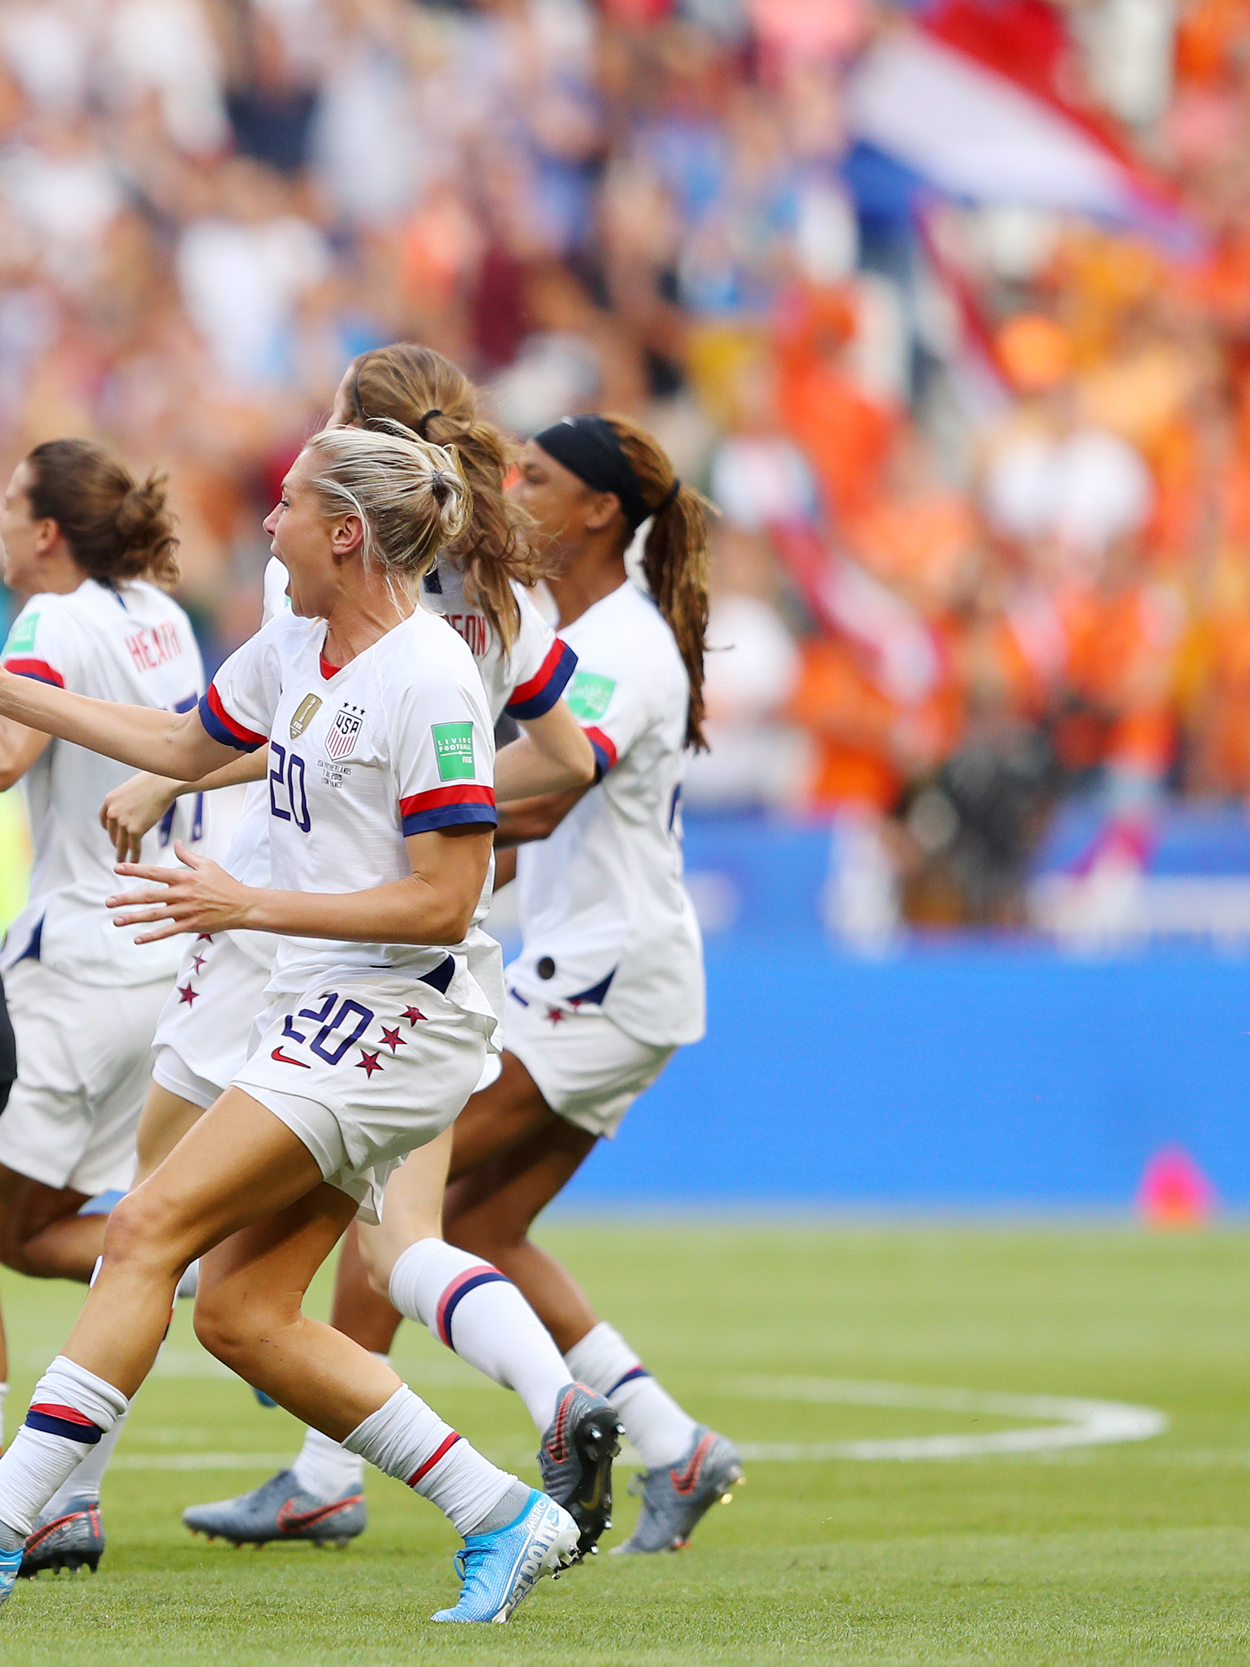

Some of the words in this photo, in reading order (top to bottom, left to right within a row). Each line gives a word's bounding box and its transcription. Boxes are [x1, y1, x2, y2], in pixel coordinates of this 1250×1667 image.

[336, 714, 359, 735] USA
[437, 737, 471, 746] LIVING
[438, 743, 472, 753] FOOTBALL
[269, 740, 311, 833] 20
[282, 993, 375, 1066] 20
